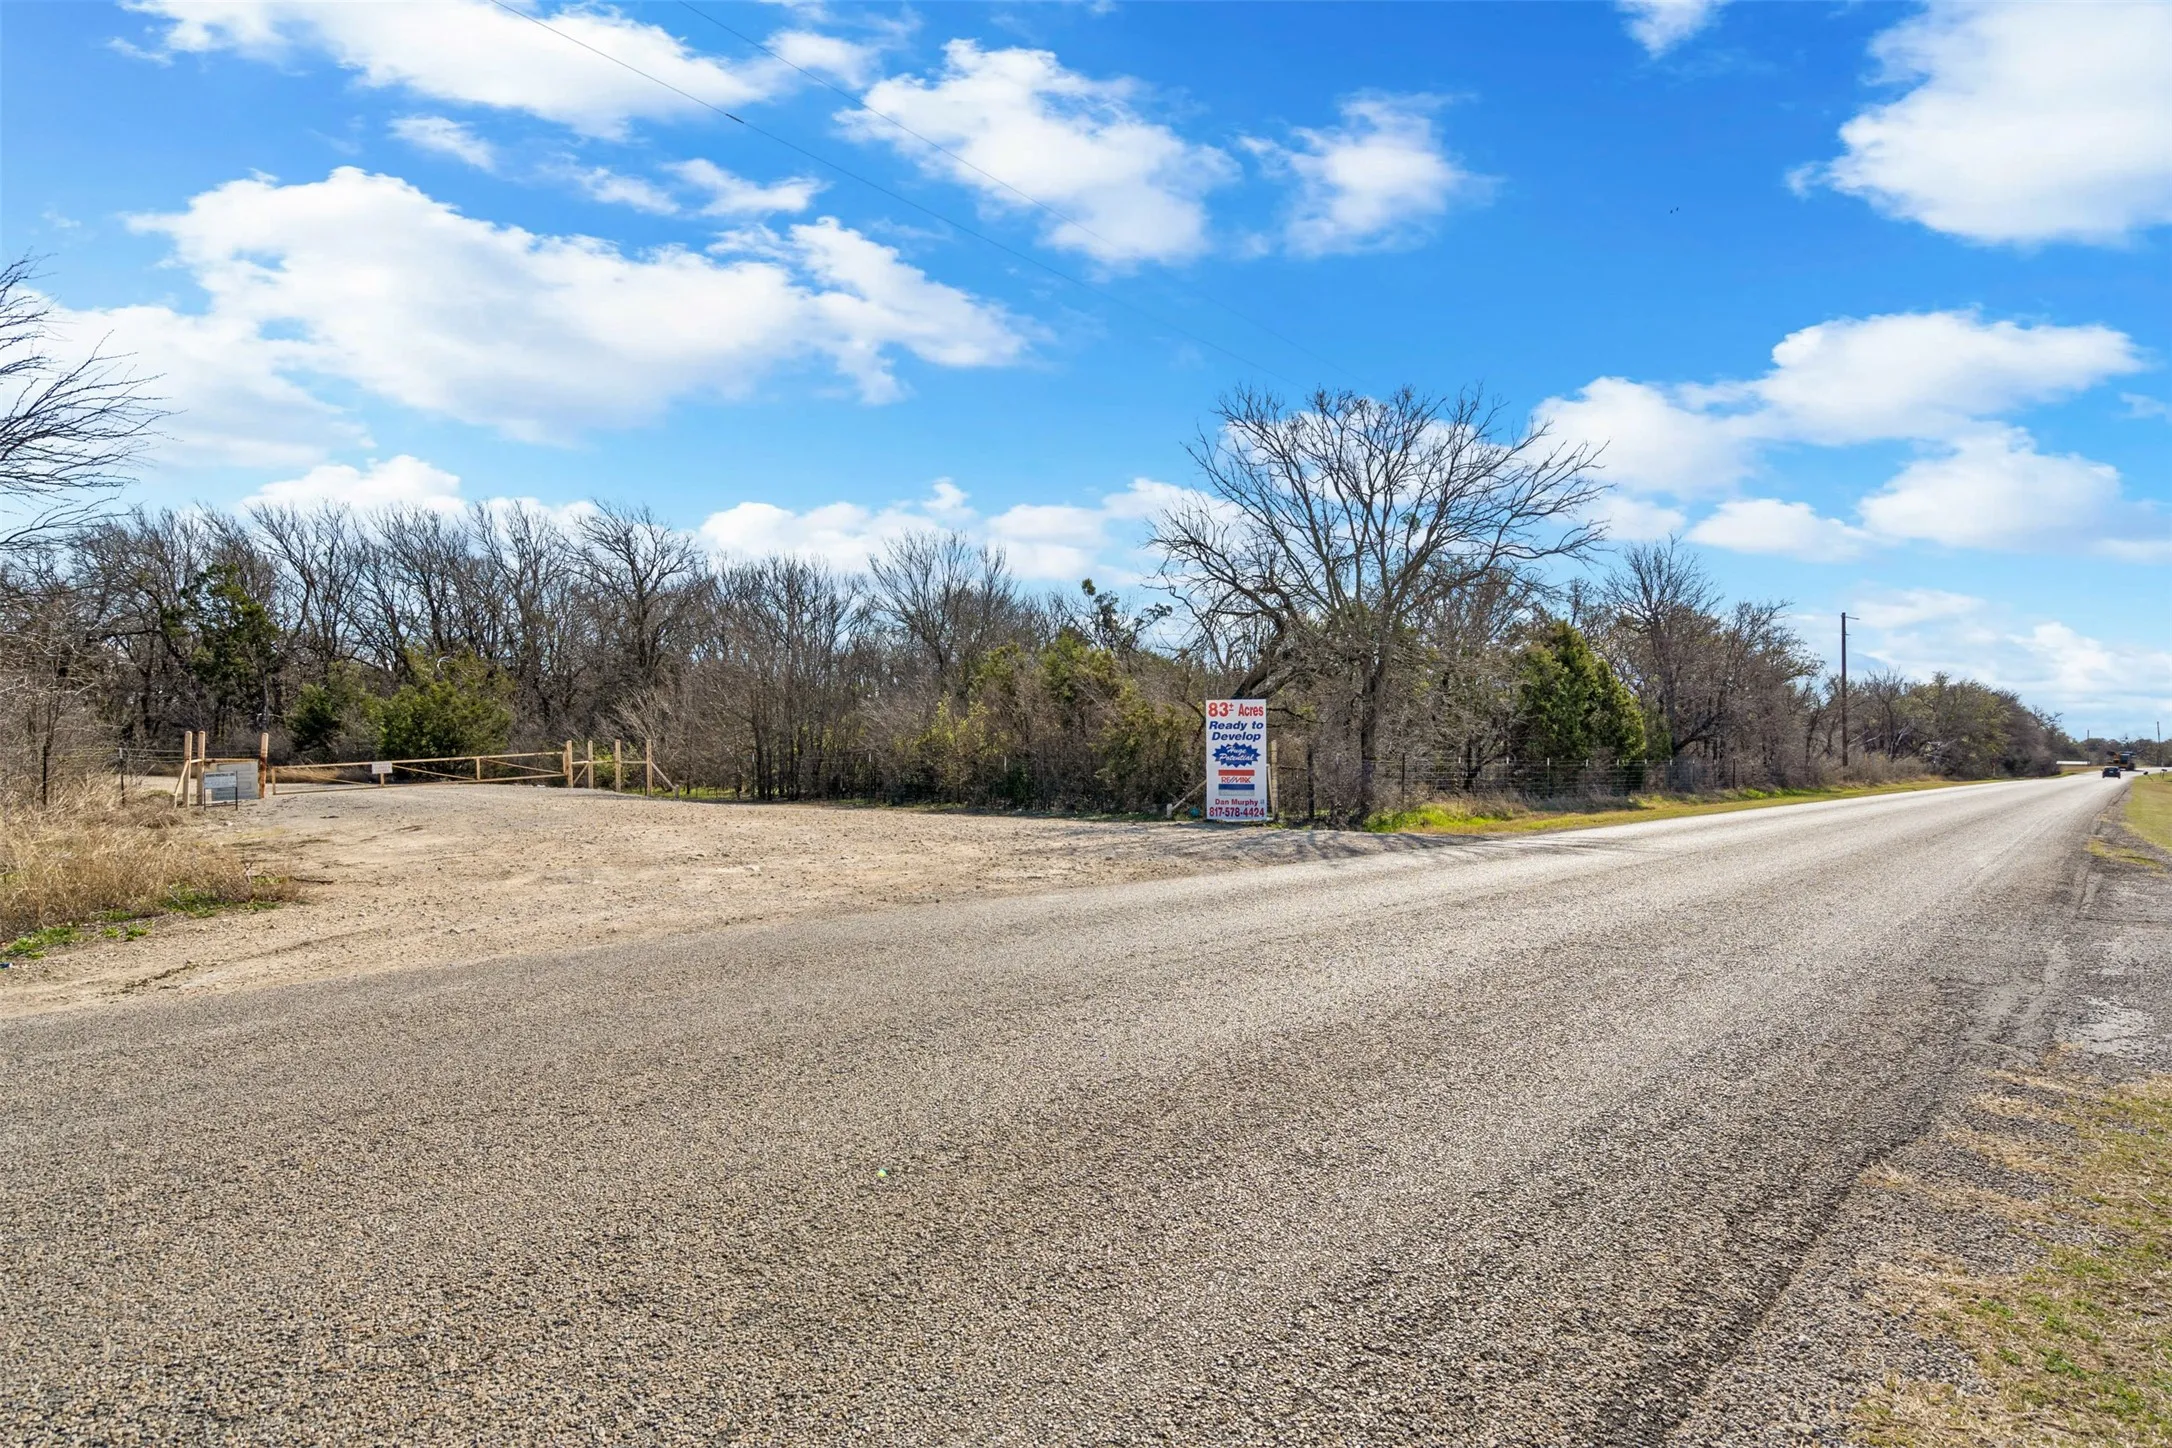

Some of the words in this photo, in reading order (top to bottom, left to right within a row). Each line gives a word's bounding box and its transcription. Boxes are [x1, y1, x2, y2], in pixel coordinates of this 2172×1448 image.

[1238, 703, 1264, 716] Acres
[1209, 721, 1247, 731] Ready
[1252, 721, 1264, 729] to
[1212, 732, 1261, 742] Develop
[1219, 753, 1254, 761] Potential
